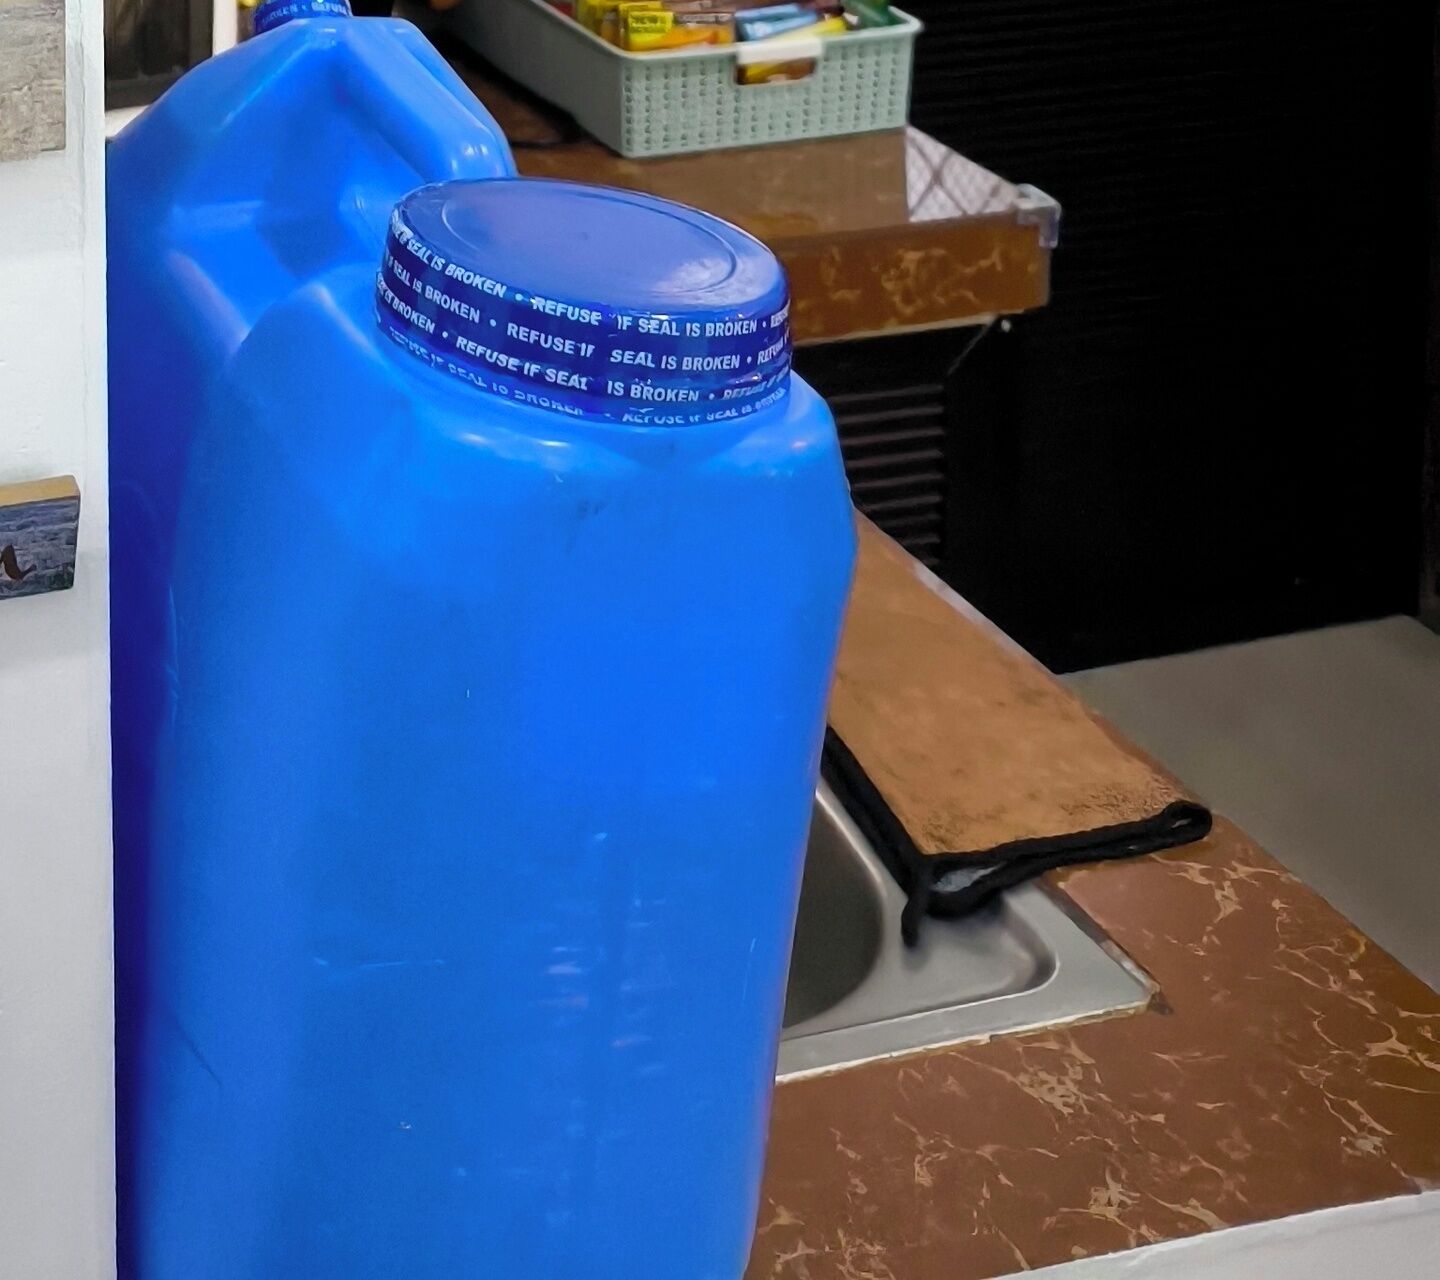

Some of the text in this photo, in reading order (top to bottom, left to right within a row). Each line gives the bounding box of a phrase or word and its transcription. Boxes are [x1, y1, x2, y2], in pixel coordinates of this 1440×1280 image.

[425, 285, 480, 324] BROKEN
[507, 322, 576, 355] REFUSE
[610, 349, 656, 368] SEAL
[661, 355, 677, 370] IS
[682, 354, 741, 371] BROKEN
[430, 256, 446, 271] IS
[445, 263, 508, 298] BROKEN
[532, 296, 602, 326] REFUSE
[616, 314, 633, 330] IF
[638, 317, 680, 336] SEAL
[686, 322, 701, 337] IS
[705, 319, 758, 337] BROKEN
[392, 296, 436, 334] BROKEN
[456, 336, 520, 371] REFUSE
[523, 362, 542, 378] IF
[607, 380, 625, 396] IS
[630, 384, 700, 403] BROKEN
